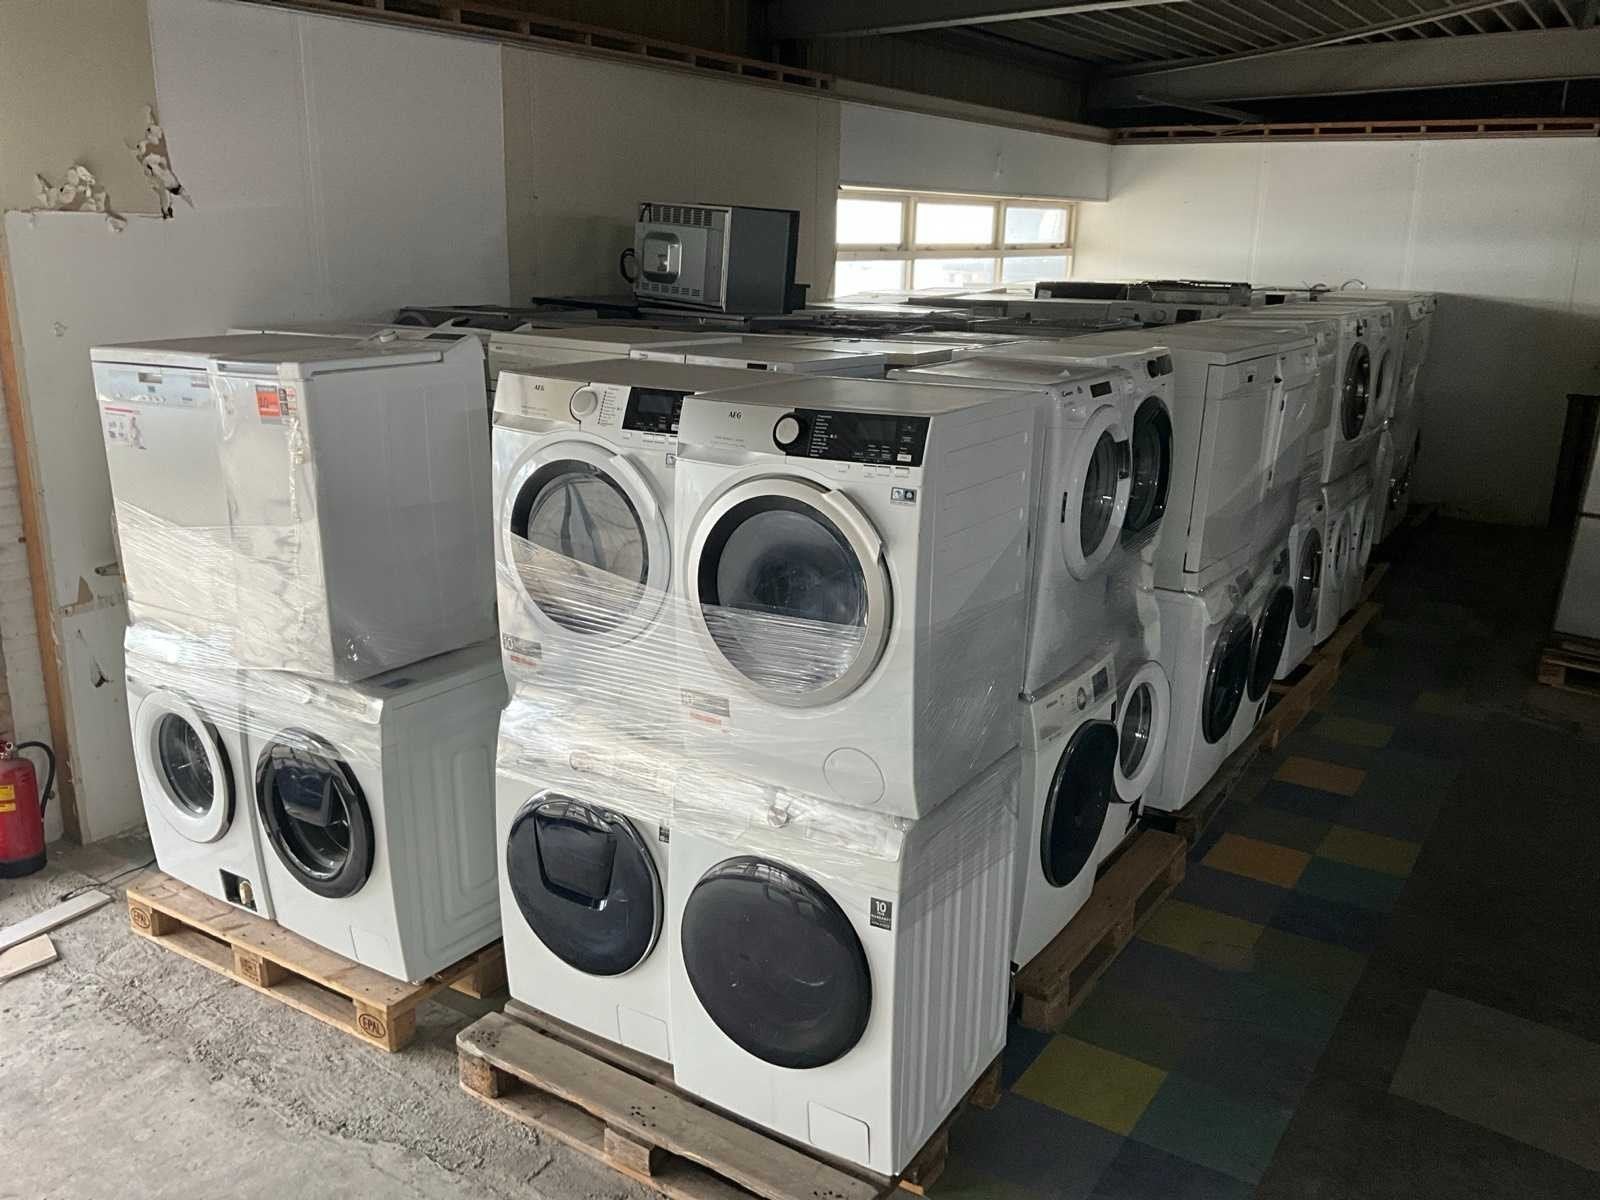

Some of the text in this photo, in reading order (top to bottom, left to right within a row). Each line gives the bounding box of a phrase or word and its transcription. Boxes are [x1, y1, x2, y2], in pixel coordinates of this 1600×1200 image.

[728, 410, 742, 419] AEG
[875, 901, 887, 913] 10
[362, 1016, 382, 1036] EPAL
